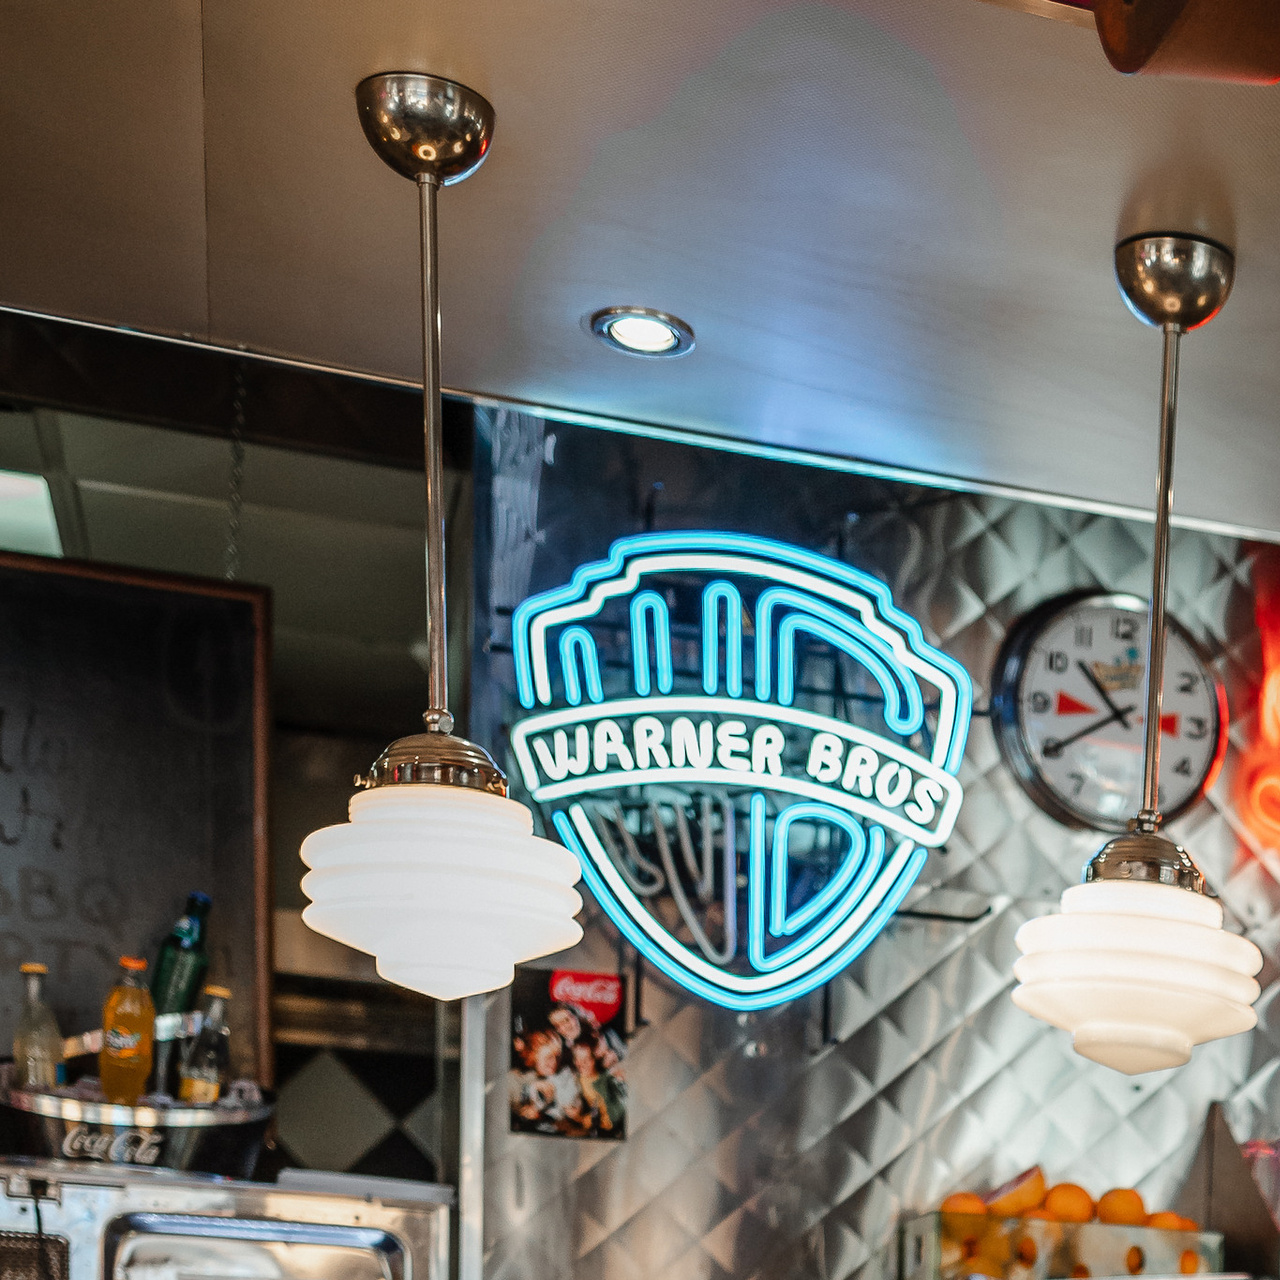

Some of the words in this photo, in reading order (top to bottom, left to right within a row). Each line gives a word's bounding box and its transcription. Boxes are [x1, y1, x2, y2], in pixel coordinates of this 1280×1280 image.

[1074, 625, 1092, 647] 11
[1111, 617, 1138, 640] 12
[1048, 651, 1068, 673] 10
[1177, 671, 1197, 694] 2
[1032, 690, 1051, 714] 9
[1185, 716, 1206, 740] 3
[532, 716, 785, 781] WARNER
[807, 732, 944, 826] BROS
[1174, 756, 1192, 777] 4
[1067, 771, 1087, 794] 7
[62, 1124, 164, 1164] Coca-Cola
